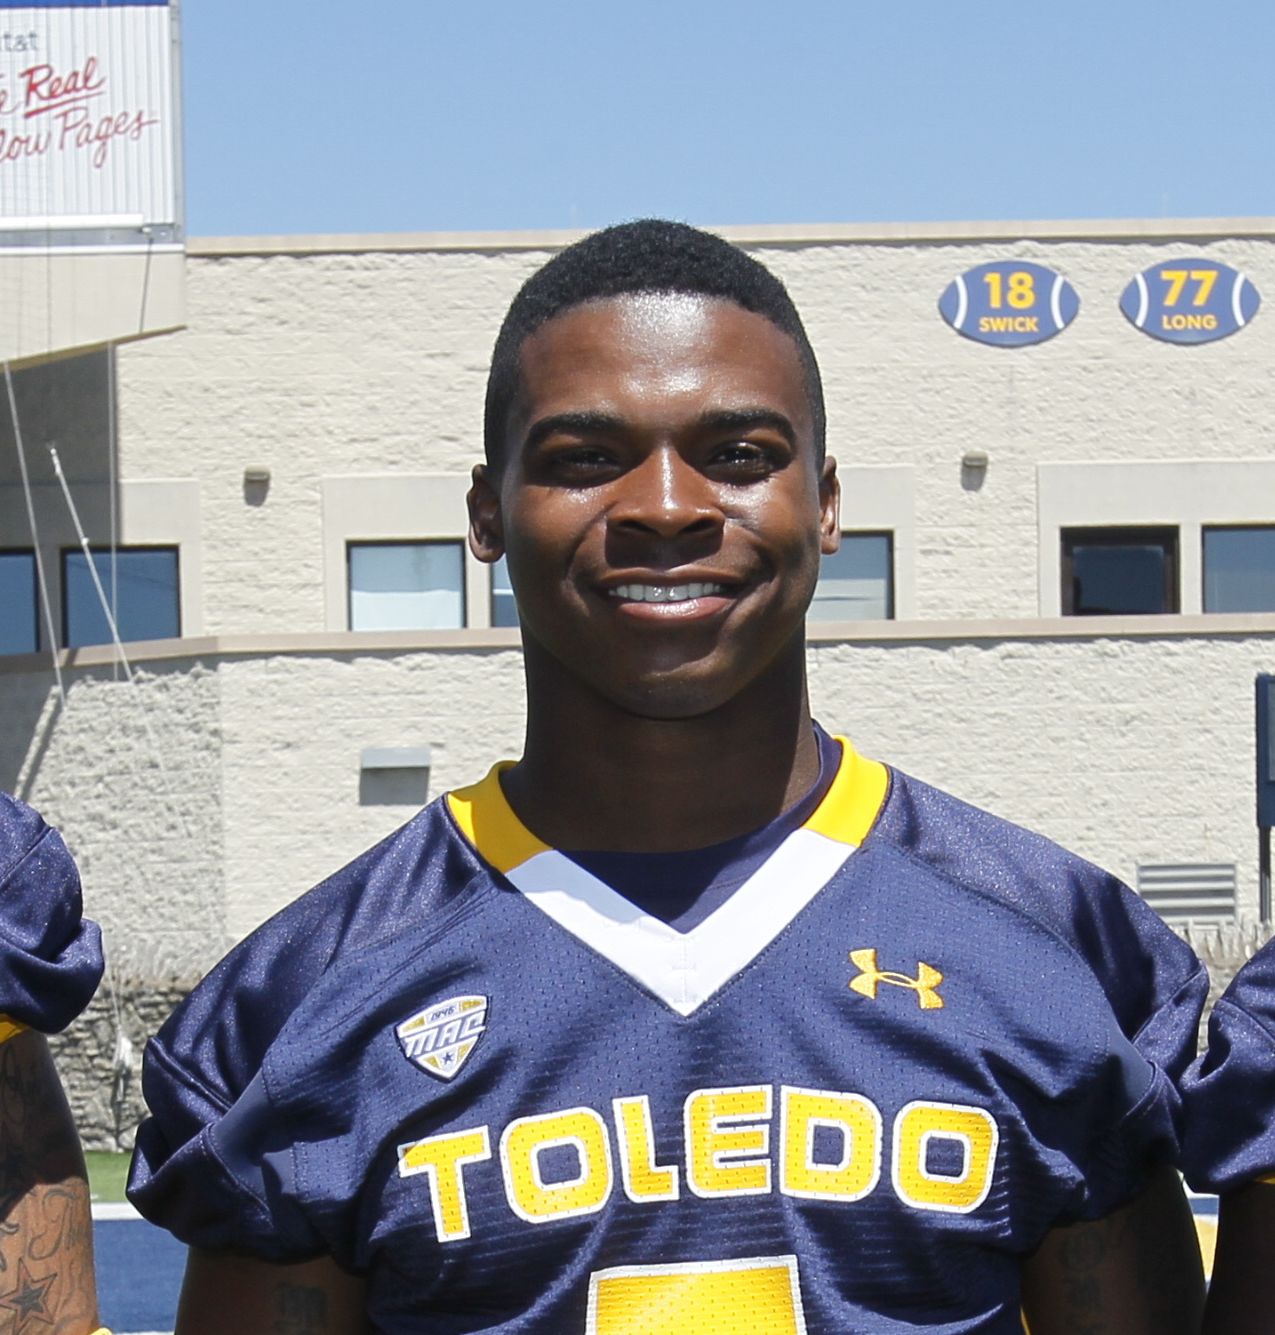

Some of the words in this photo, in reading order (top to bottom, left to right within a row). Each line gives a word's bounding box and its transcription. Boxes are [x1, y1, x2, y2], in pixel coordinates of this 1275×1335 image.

[19, 57, 106, 107] Real
[54, 106, 160, 168] Pages
[983, 272, 1035, 309] 18
[1160, 269, 1218, 306] 77
[979, 316, 1039, 332] SWICK
[1162, 314, 1218, 330] LONG
[405, 1010, 486, 1058] MAC
[397, 1084, 1000, 1243] TOLEDO
